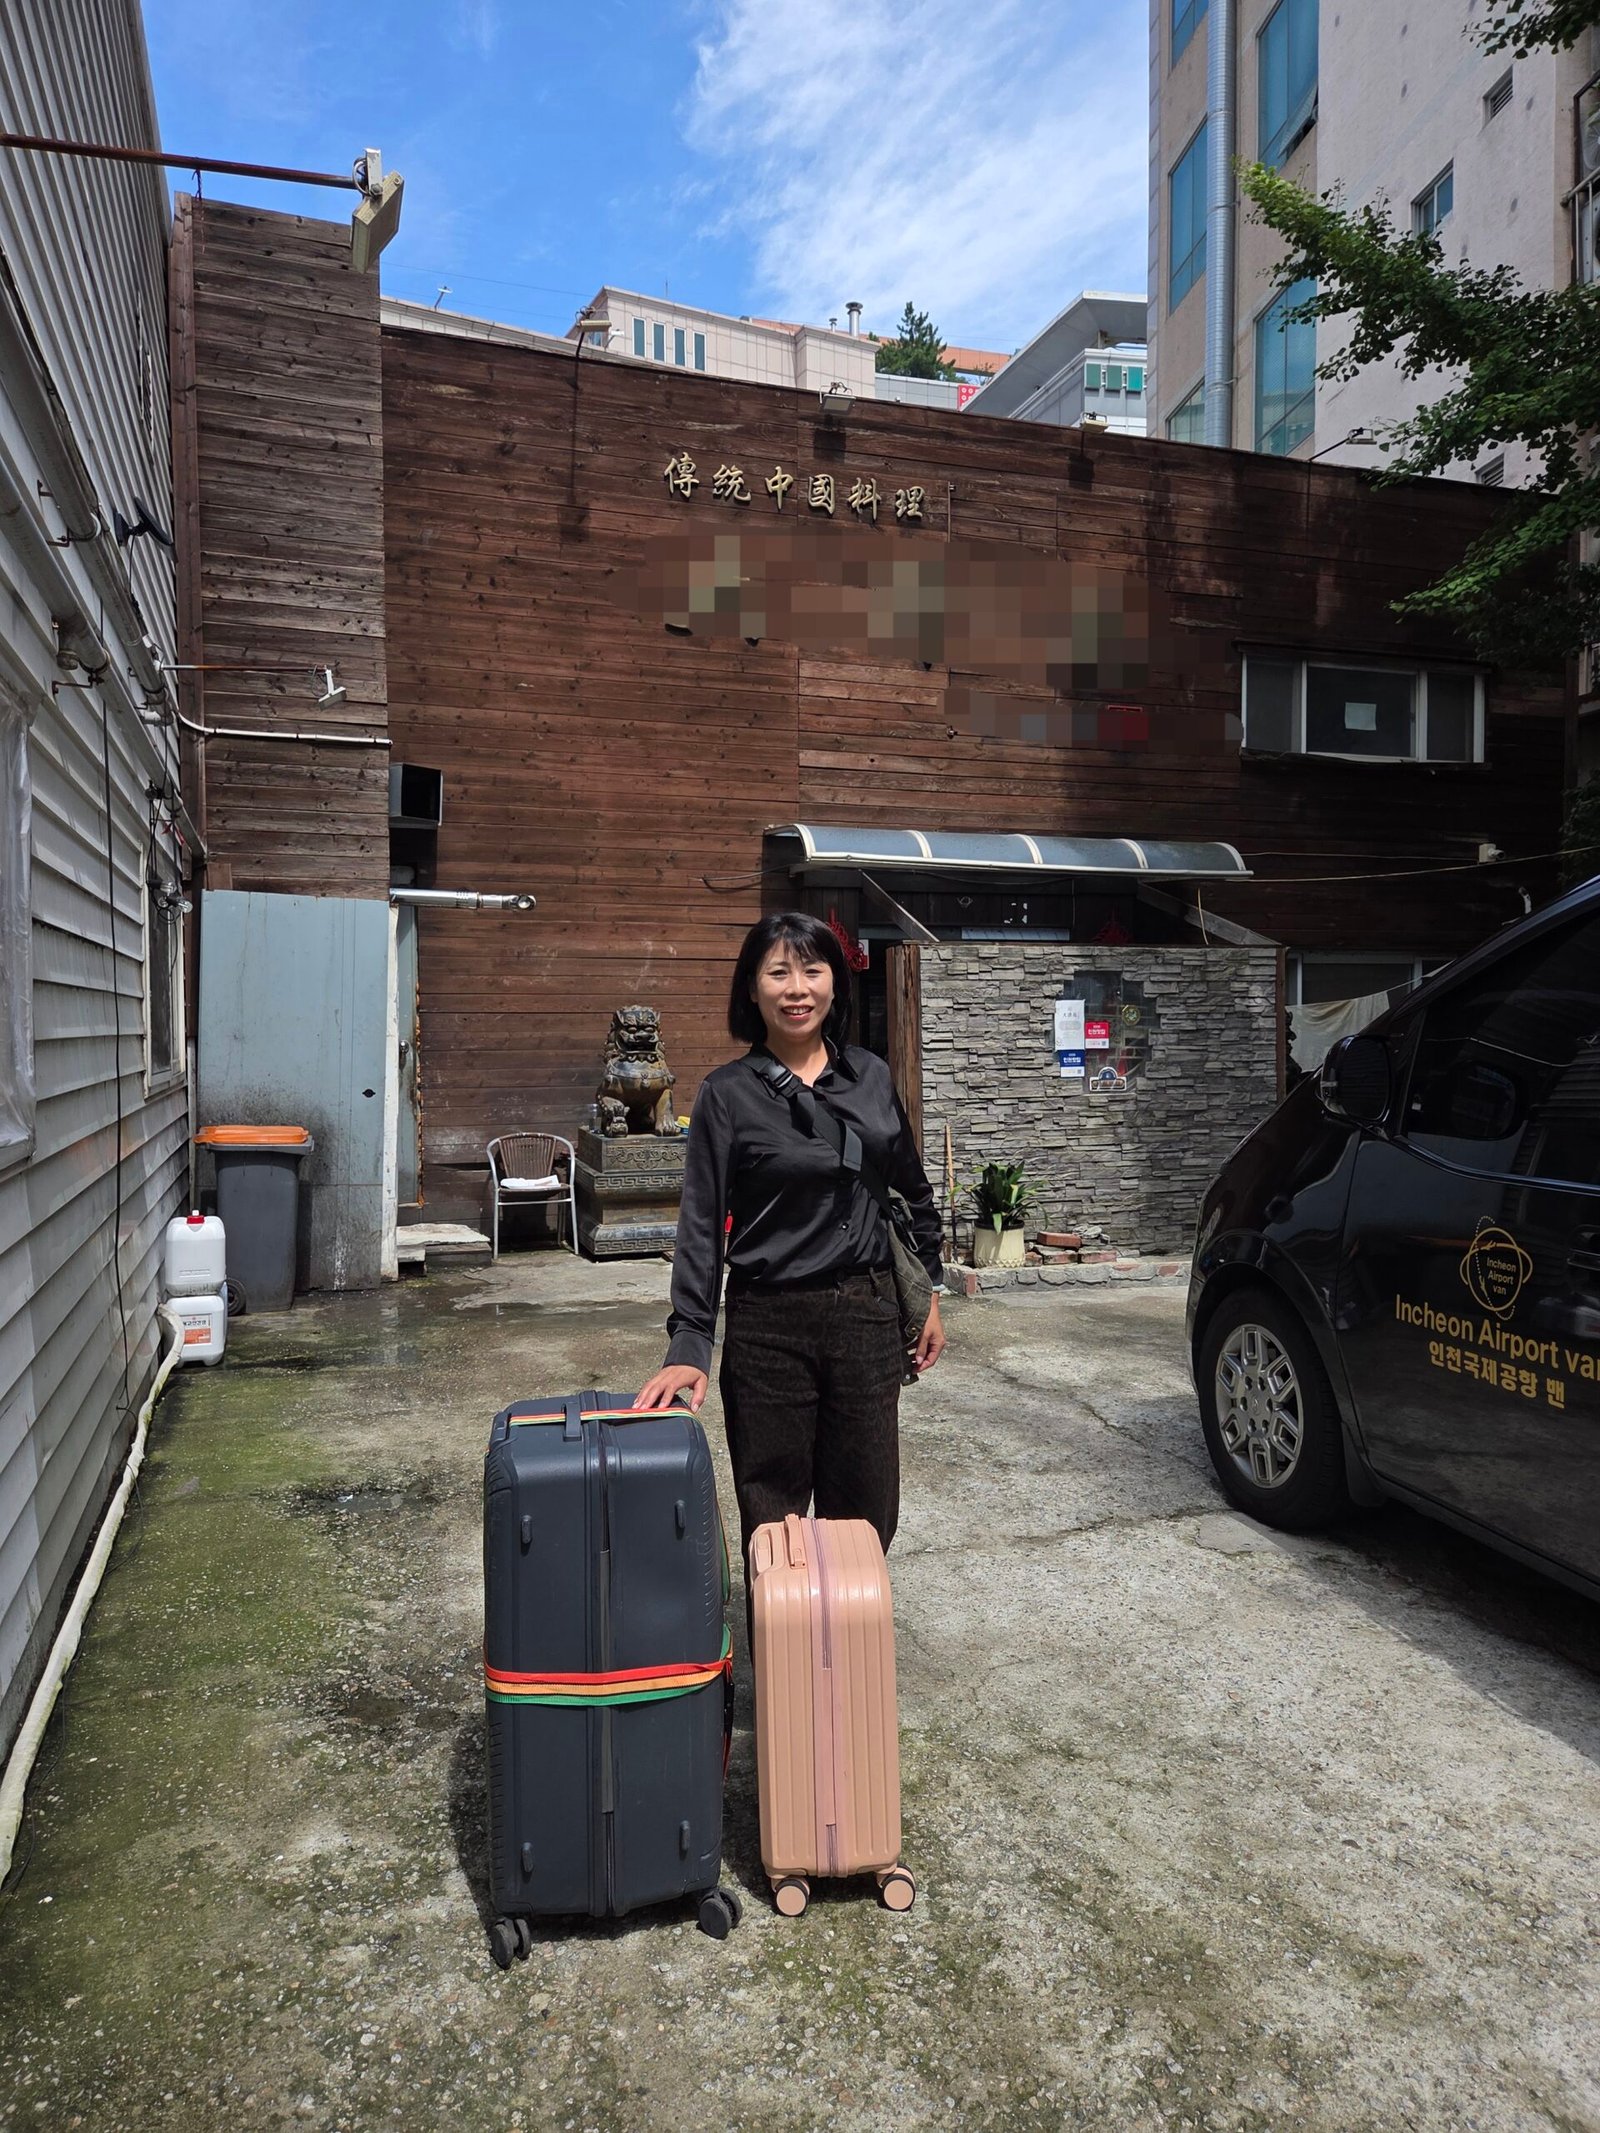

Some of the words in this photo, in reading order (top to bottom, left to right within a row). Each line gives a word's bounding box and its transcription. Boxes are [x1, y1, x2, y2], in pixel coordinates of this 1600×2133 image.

[664, 452, 925, 521] 傳統中國料理
[1486, 1256, 1517, 1272] Incheon
[1487, 1270, 1514, 1285] Airport
[1493, 1285, 1507, 1295] van
[1396, 1294, 1474, 1343] Incheon
[1478, 1319, 1559, 1369] Airport
[1546, 1377, 1565, 1409] 밴
